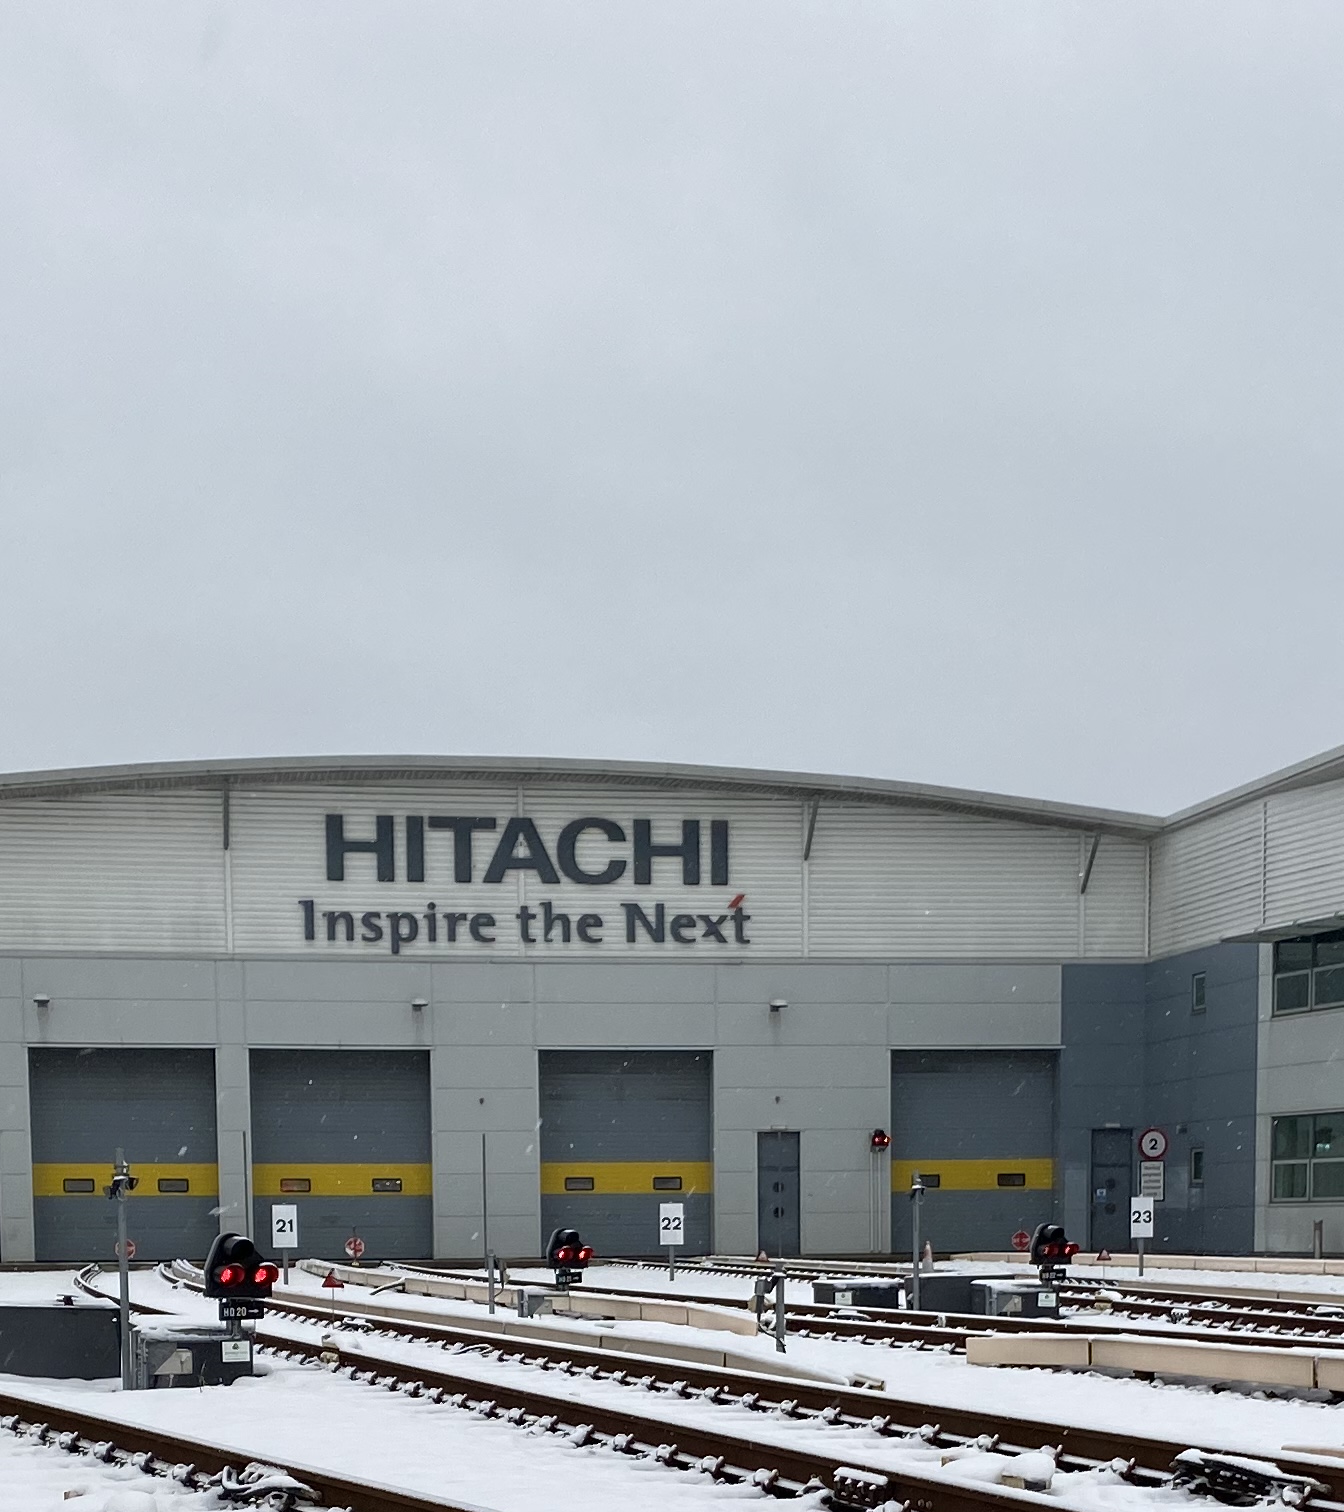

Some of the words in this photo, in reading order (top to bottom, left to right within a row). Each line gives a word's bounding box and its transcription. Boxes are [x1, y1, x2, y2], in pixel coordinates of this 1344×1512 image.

[325, 814, 729, 886] HITACHI
[298, 900, 497, 954] Inspire
[516, 901, 603, 943] the
[620, 894, 751, 944] Next
[1148, 1138, 1158, 1150] 2
[661, 1216, 682, 1231] 22
[1132, 1210, 1152, 1224] 23
[275, 1219, 294, 1233] 21
[236, 1306, 247, 1317] 20
